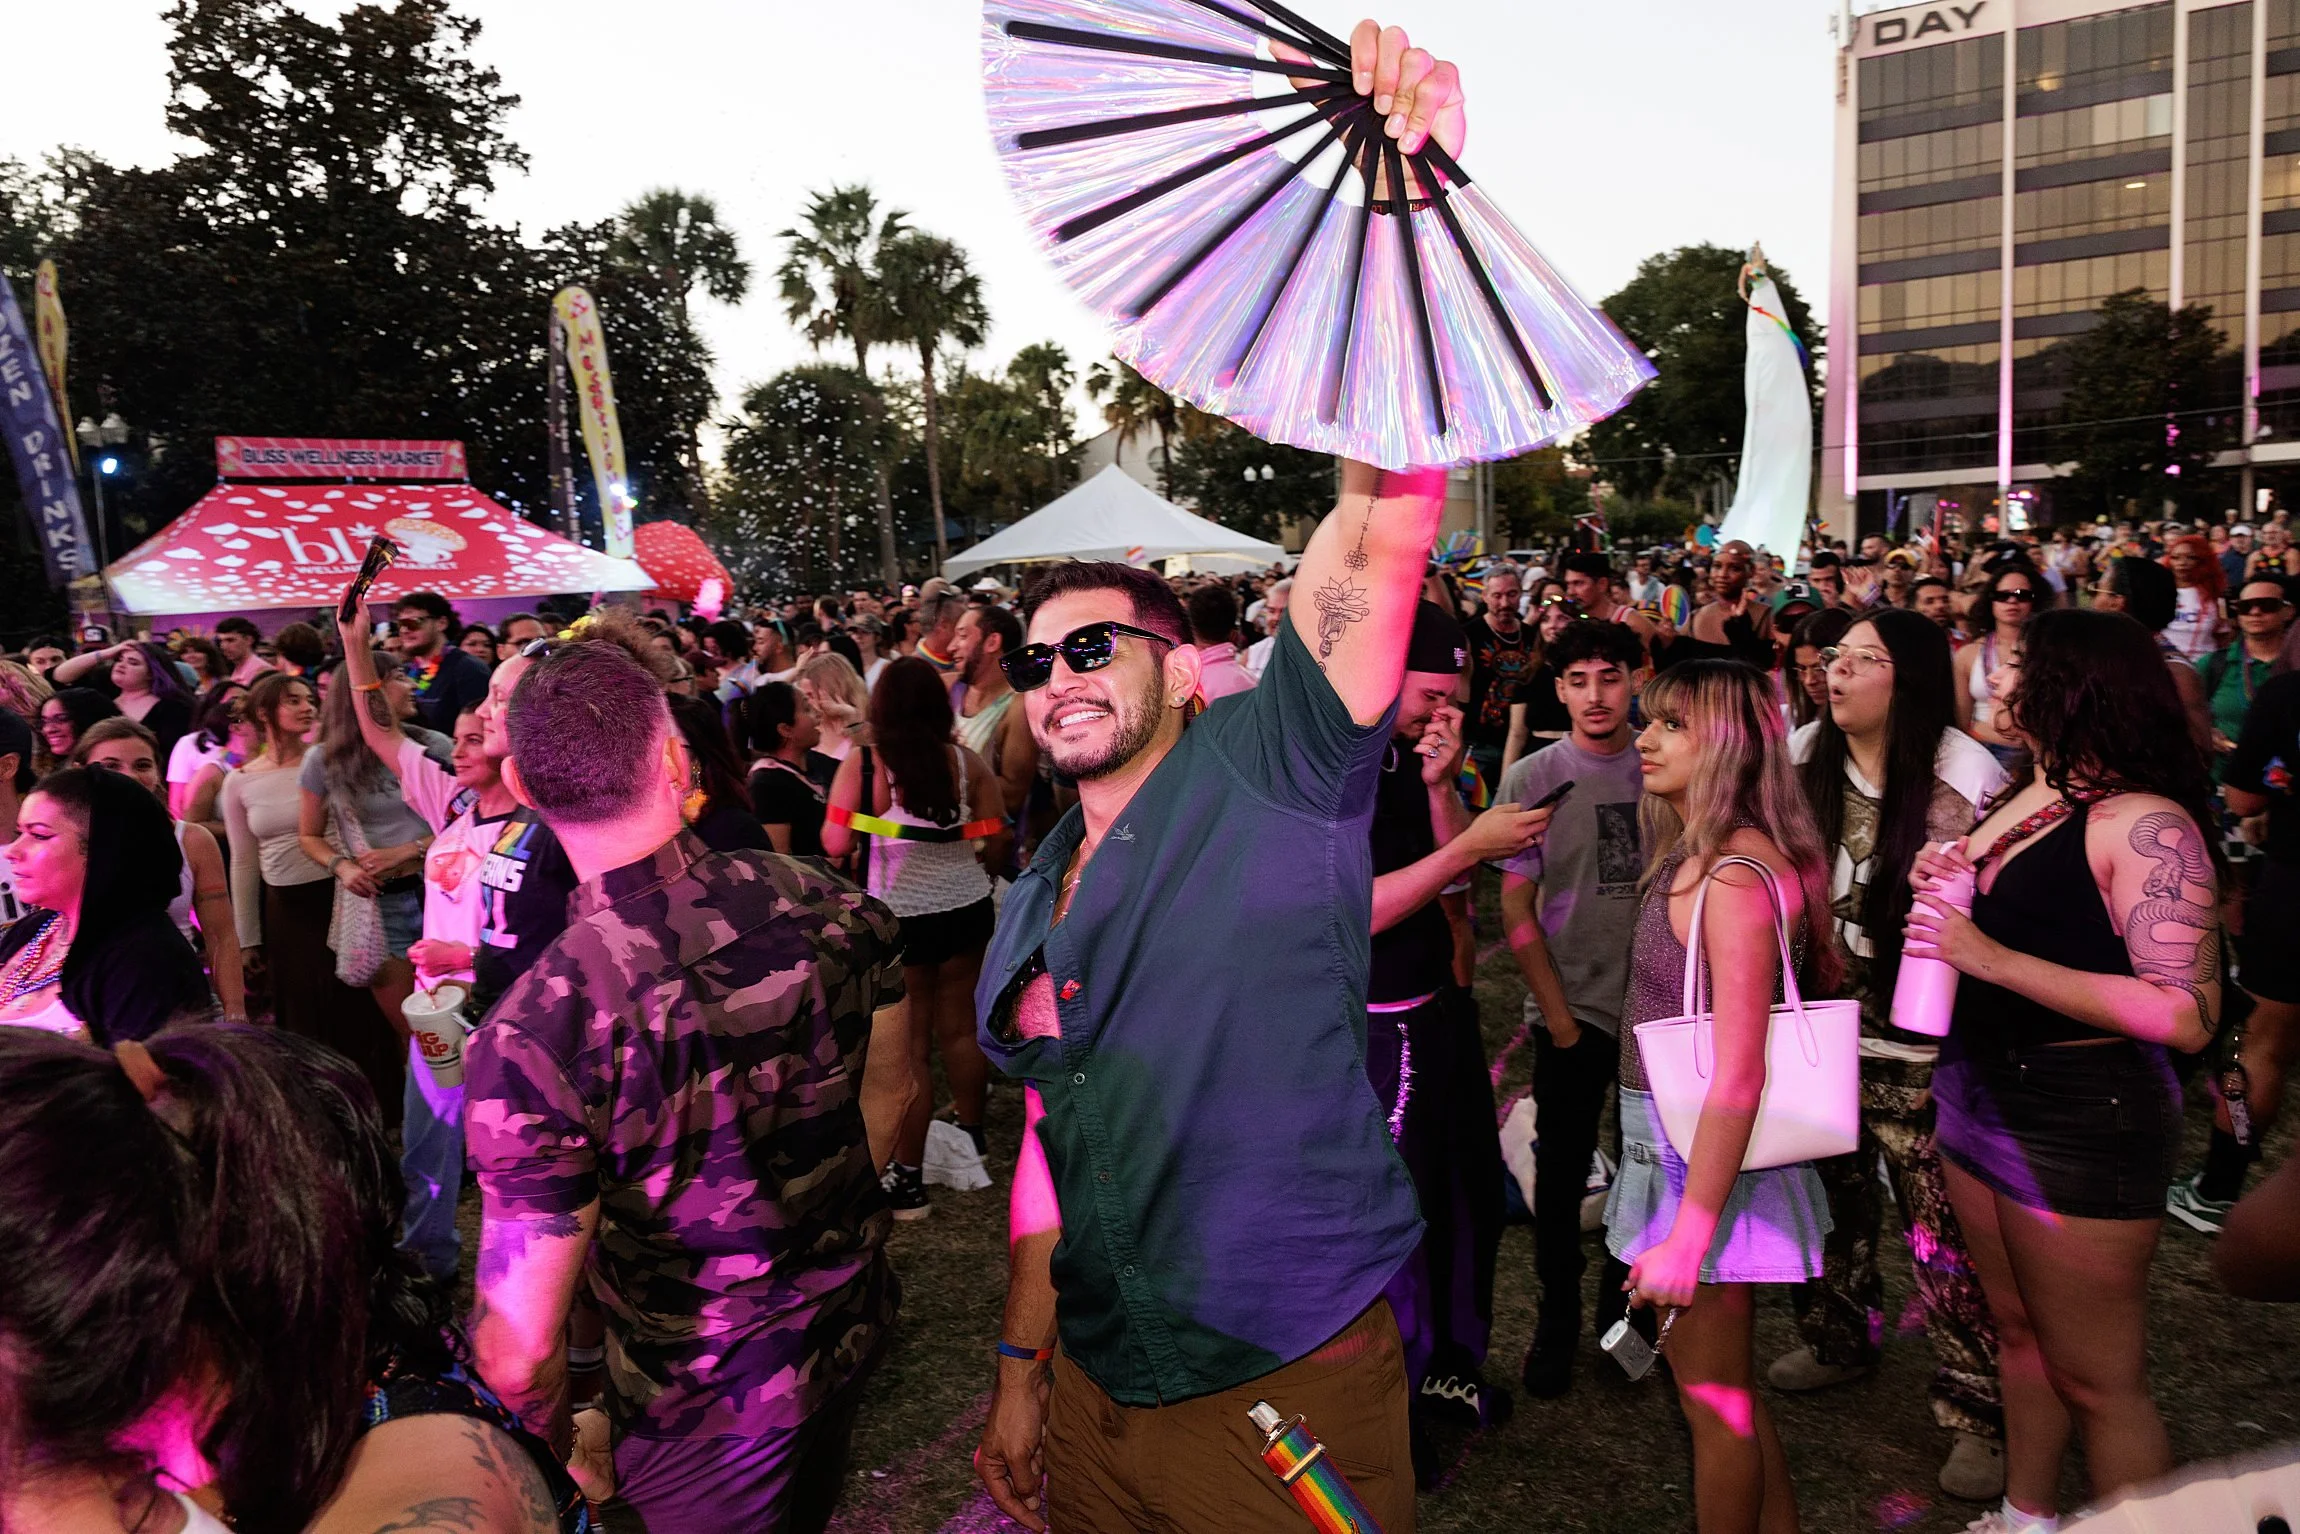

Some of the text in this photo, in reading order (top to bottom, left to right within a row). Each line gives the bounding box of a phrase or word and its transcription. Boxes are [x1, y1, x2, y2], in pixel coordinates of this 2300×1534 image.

[1875, 1, 1987, 46] DAY
[243, 448, 444, 466] BLISS WELLNESS MARKET
[22, 430, 78, 571] DRINKS
